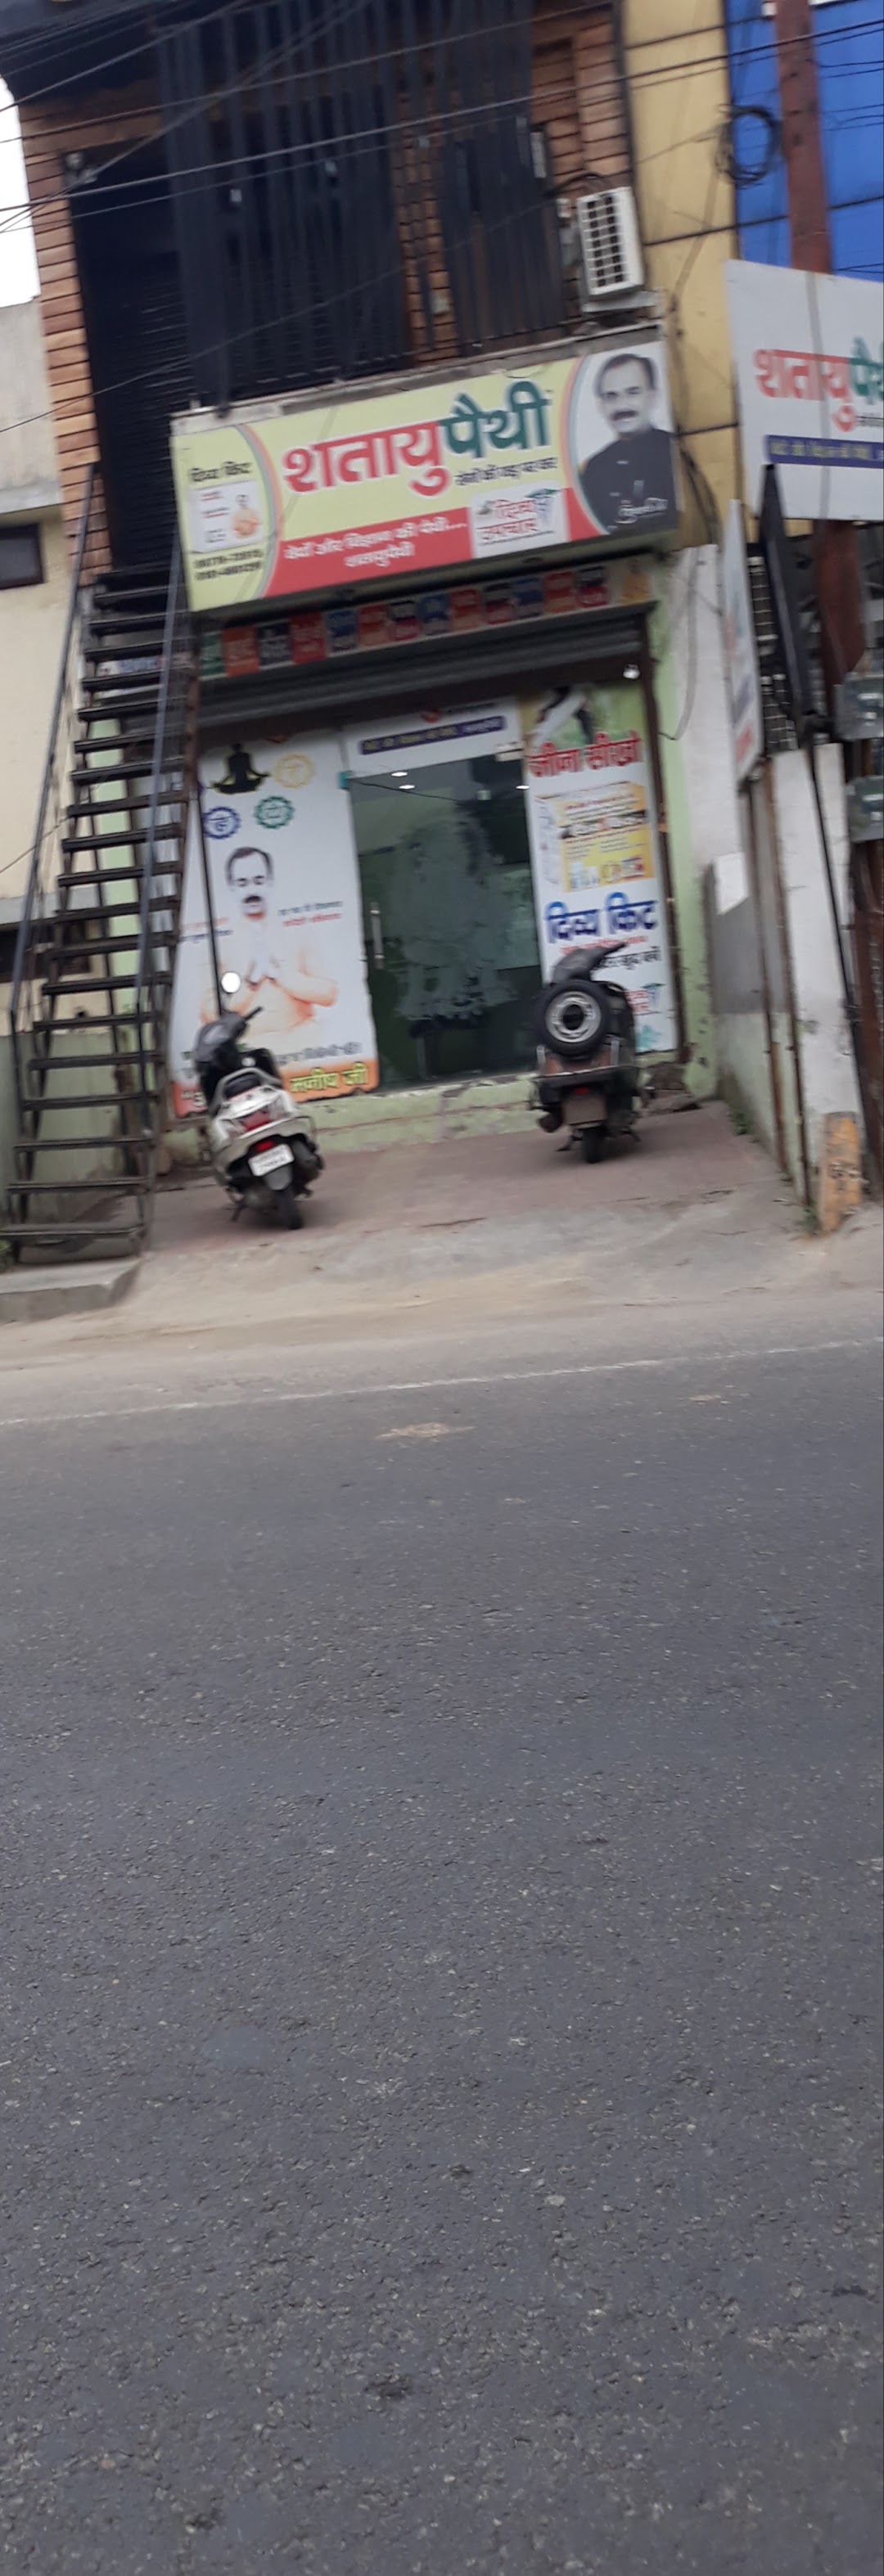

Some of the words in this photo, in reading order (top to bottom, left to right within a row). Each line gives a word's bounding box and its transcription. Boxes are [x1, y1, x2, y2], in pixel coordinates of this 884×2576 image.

[752, 336, 883, 433] शतायुपै
[283, 381, 552, 497] शतायुपैथी
[529, 741, 581, 778] जीना
[584, 730, 643, 770] सीखो
[545, 901, 601, 943] दिव्य
[605, 891, 658, 934] किट
[341, 1061, 368, 1086] जी
